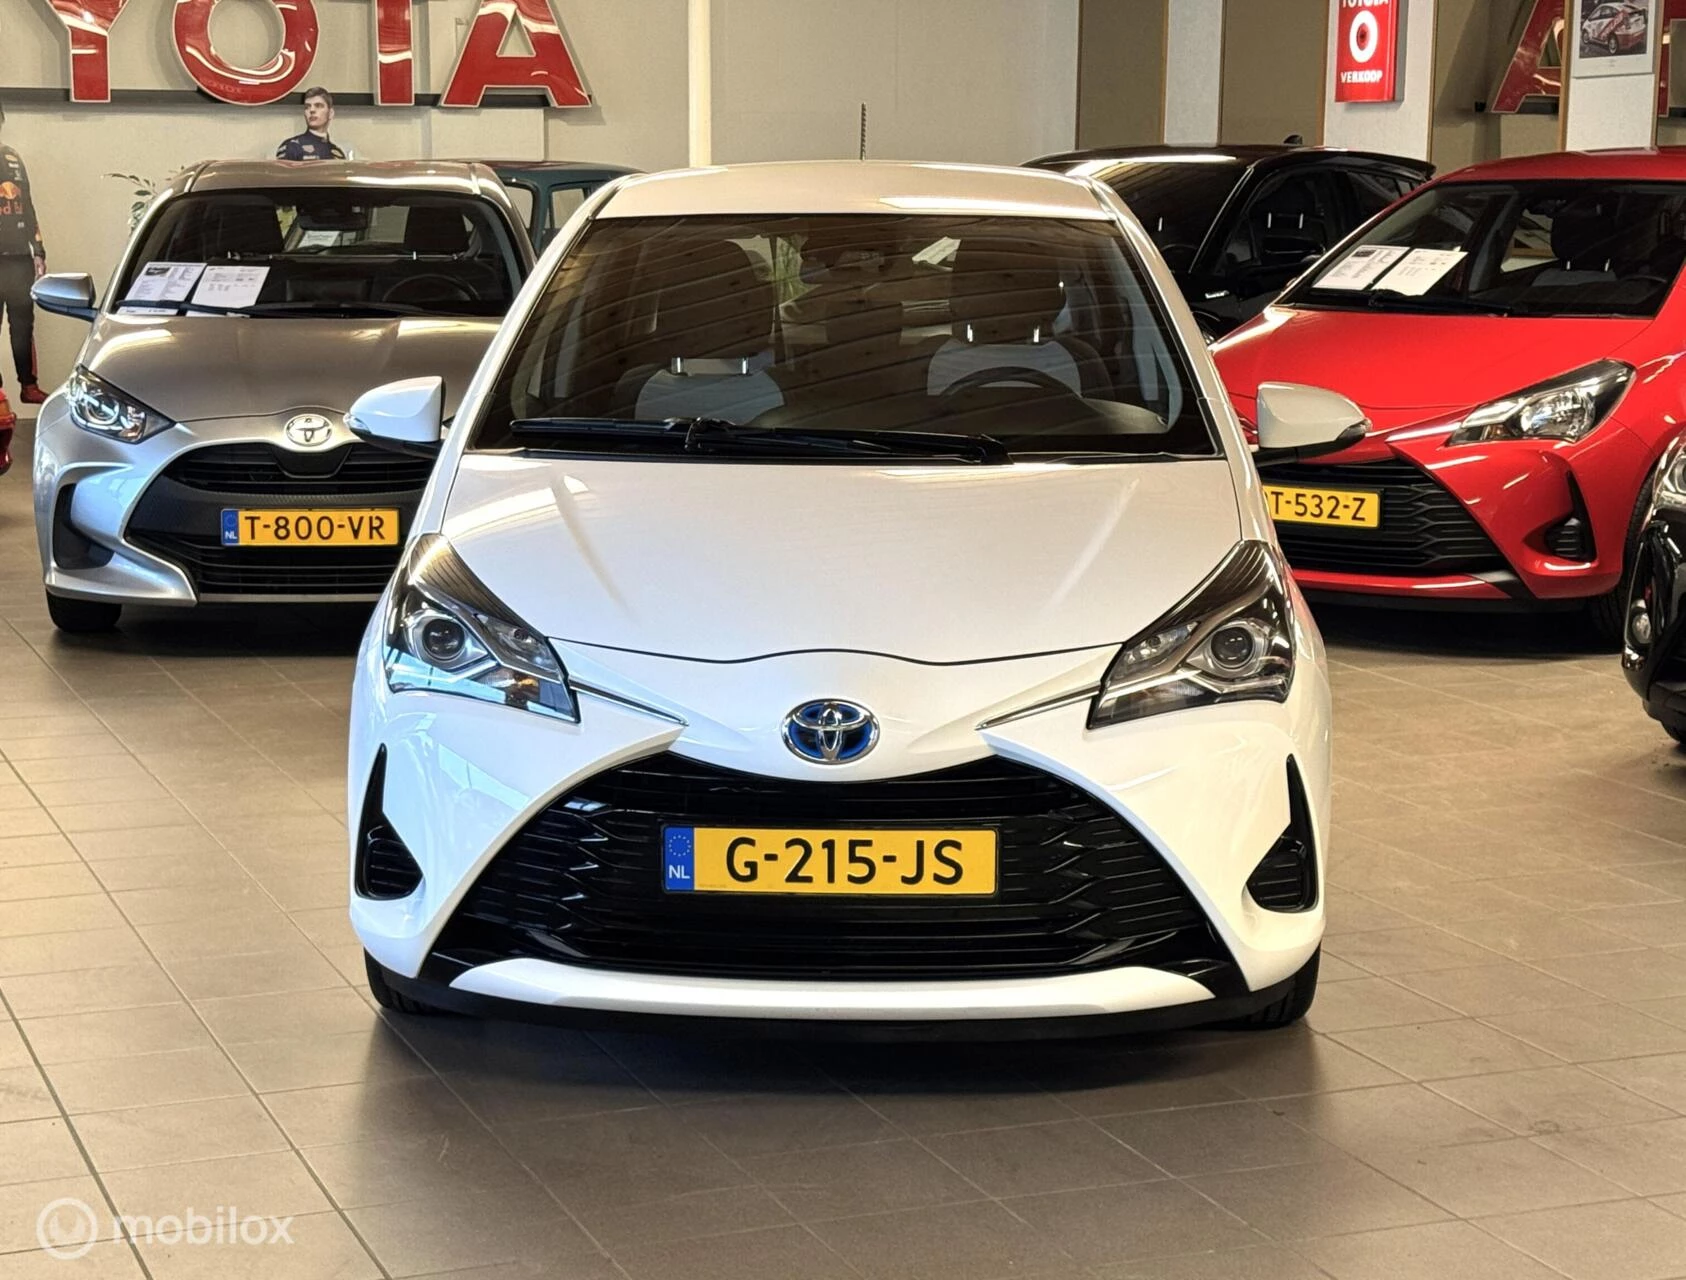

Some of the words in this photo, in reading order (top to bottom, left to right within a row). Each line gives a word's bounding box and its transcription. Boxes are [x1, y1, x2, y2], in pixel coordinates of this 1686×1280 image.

[1265, 491, 1366, 521] T-532-Z
[225, 531, 237, 540] NL
[244, 515, 385, 540] T-800-VR
[668, 865, 690, 879] NL
[726, 836, 964, 885] G-215-JS
